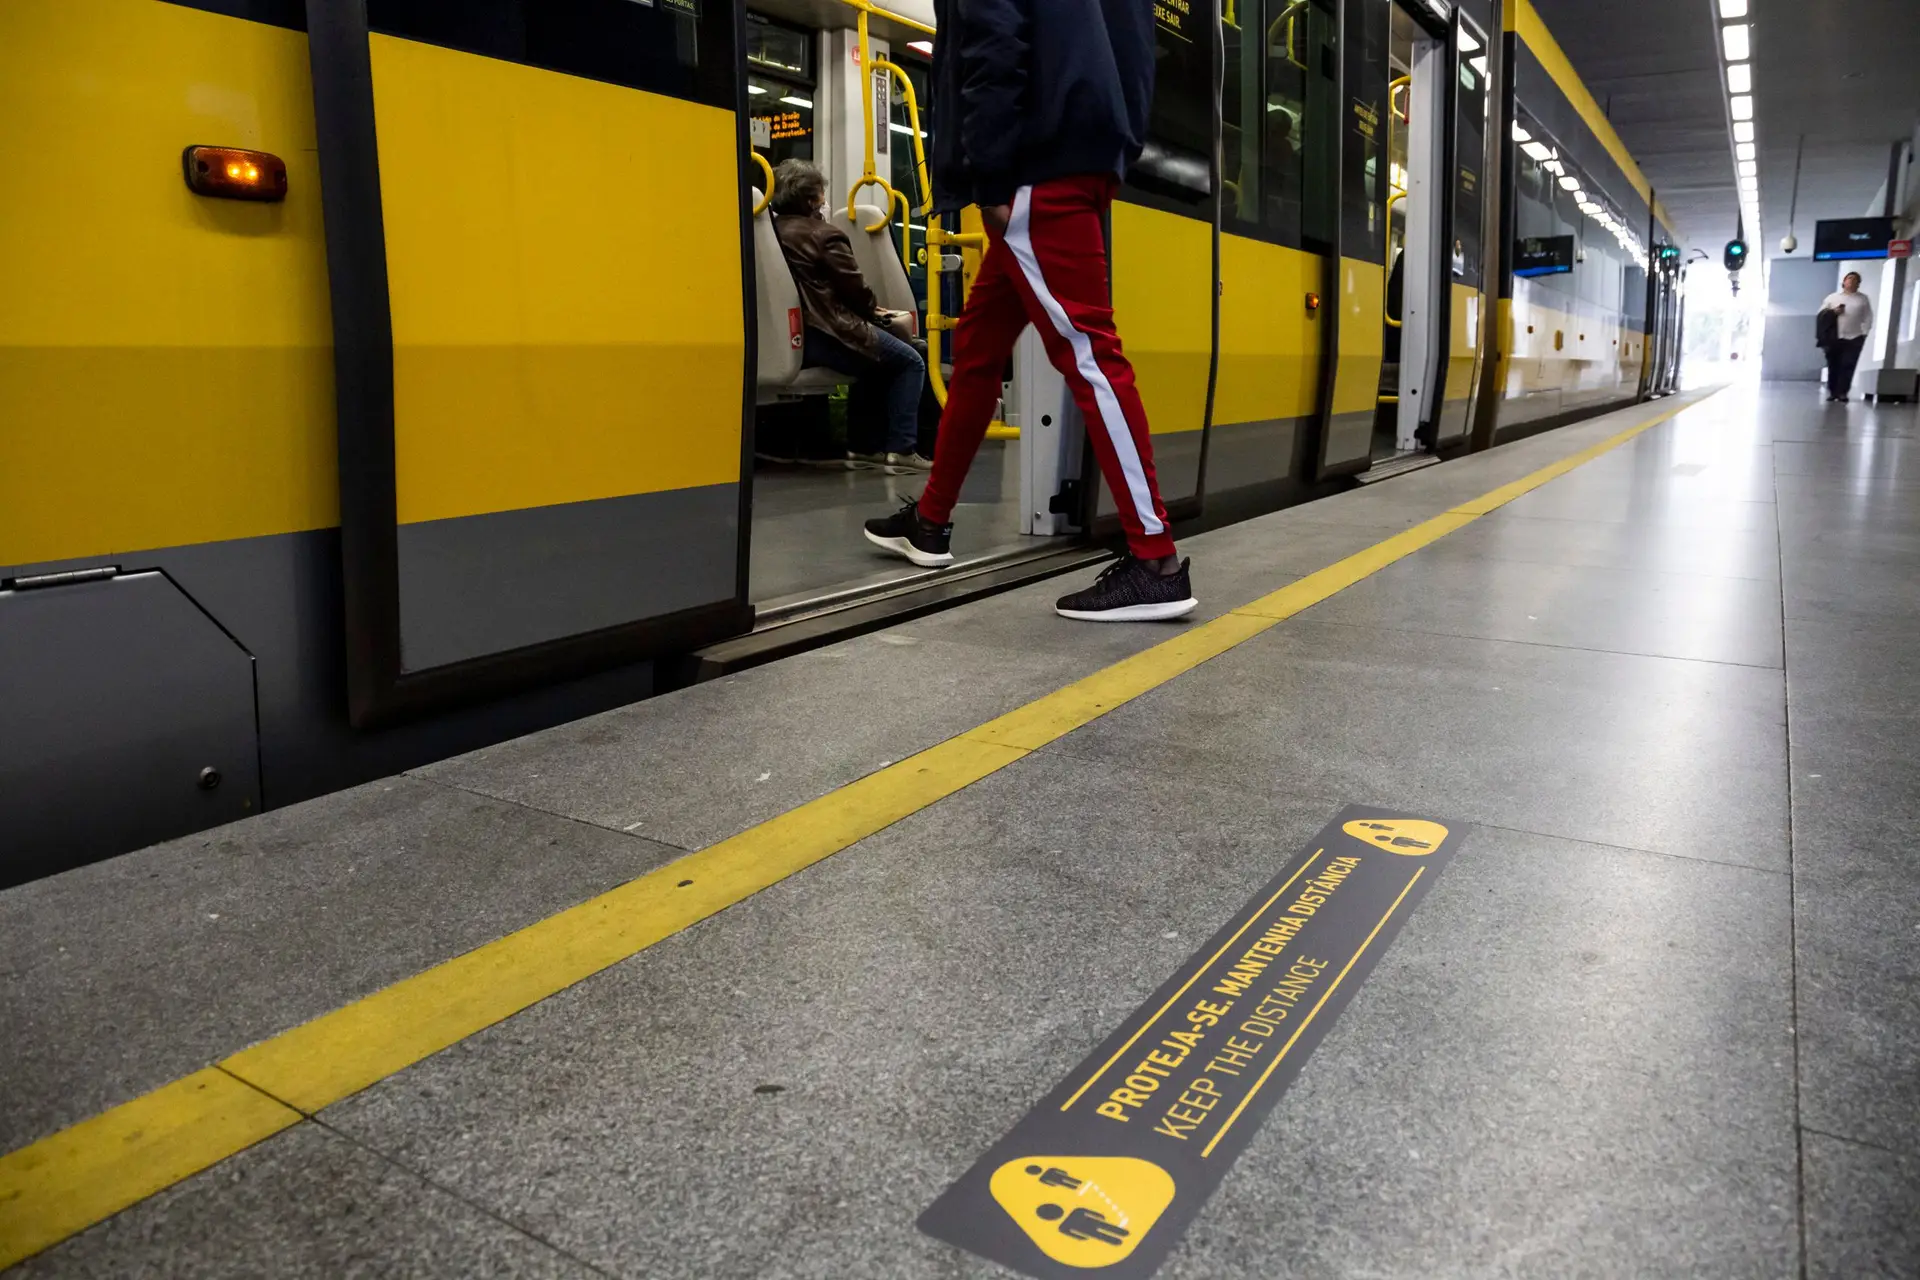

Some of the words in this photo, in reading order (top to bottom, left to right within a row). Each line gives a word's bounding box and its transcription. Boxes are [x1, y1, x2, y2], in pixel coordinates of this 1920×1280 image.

[1096, 1000, 1235, 1122] PROTEJA-SE.
[1212, 916, 1309, 997] MANTENHA
[1287, 856, 1362, 916] DISTÂNCIA
[1153, 1078, 1223, 1140] KEEP
[1204, 1035, 1264, 1076] THE
[1240, 955, 1329, 1037] DISTANCE
